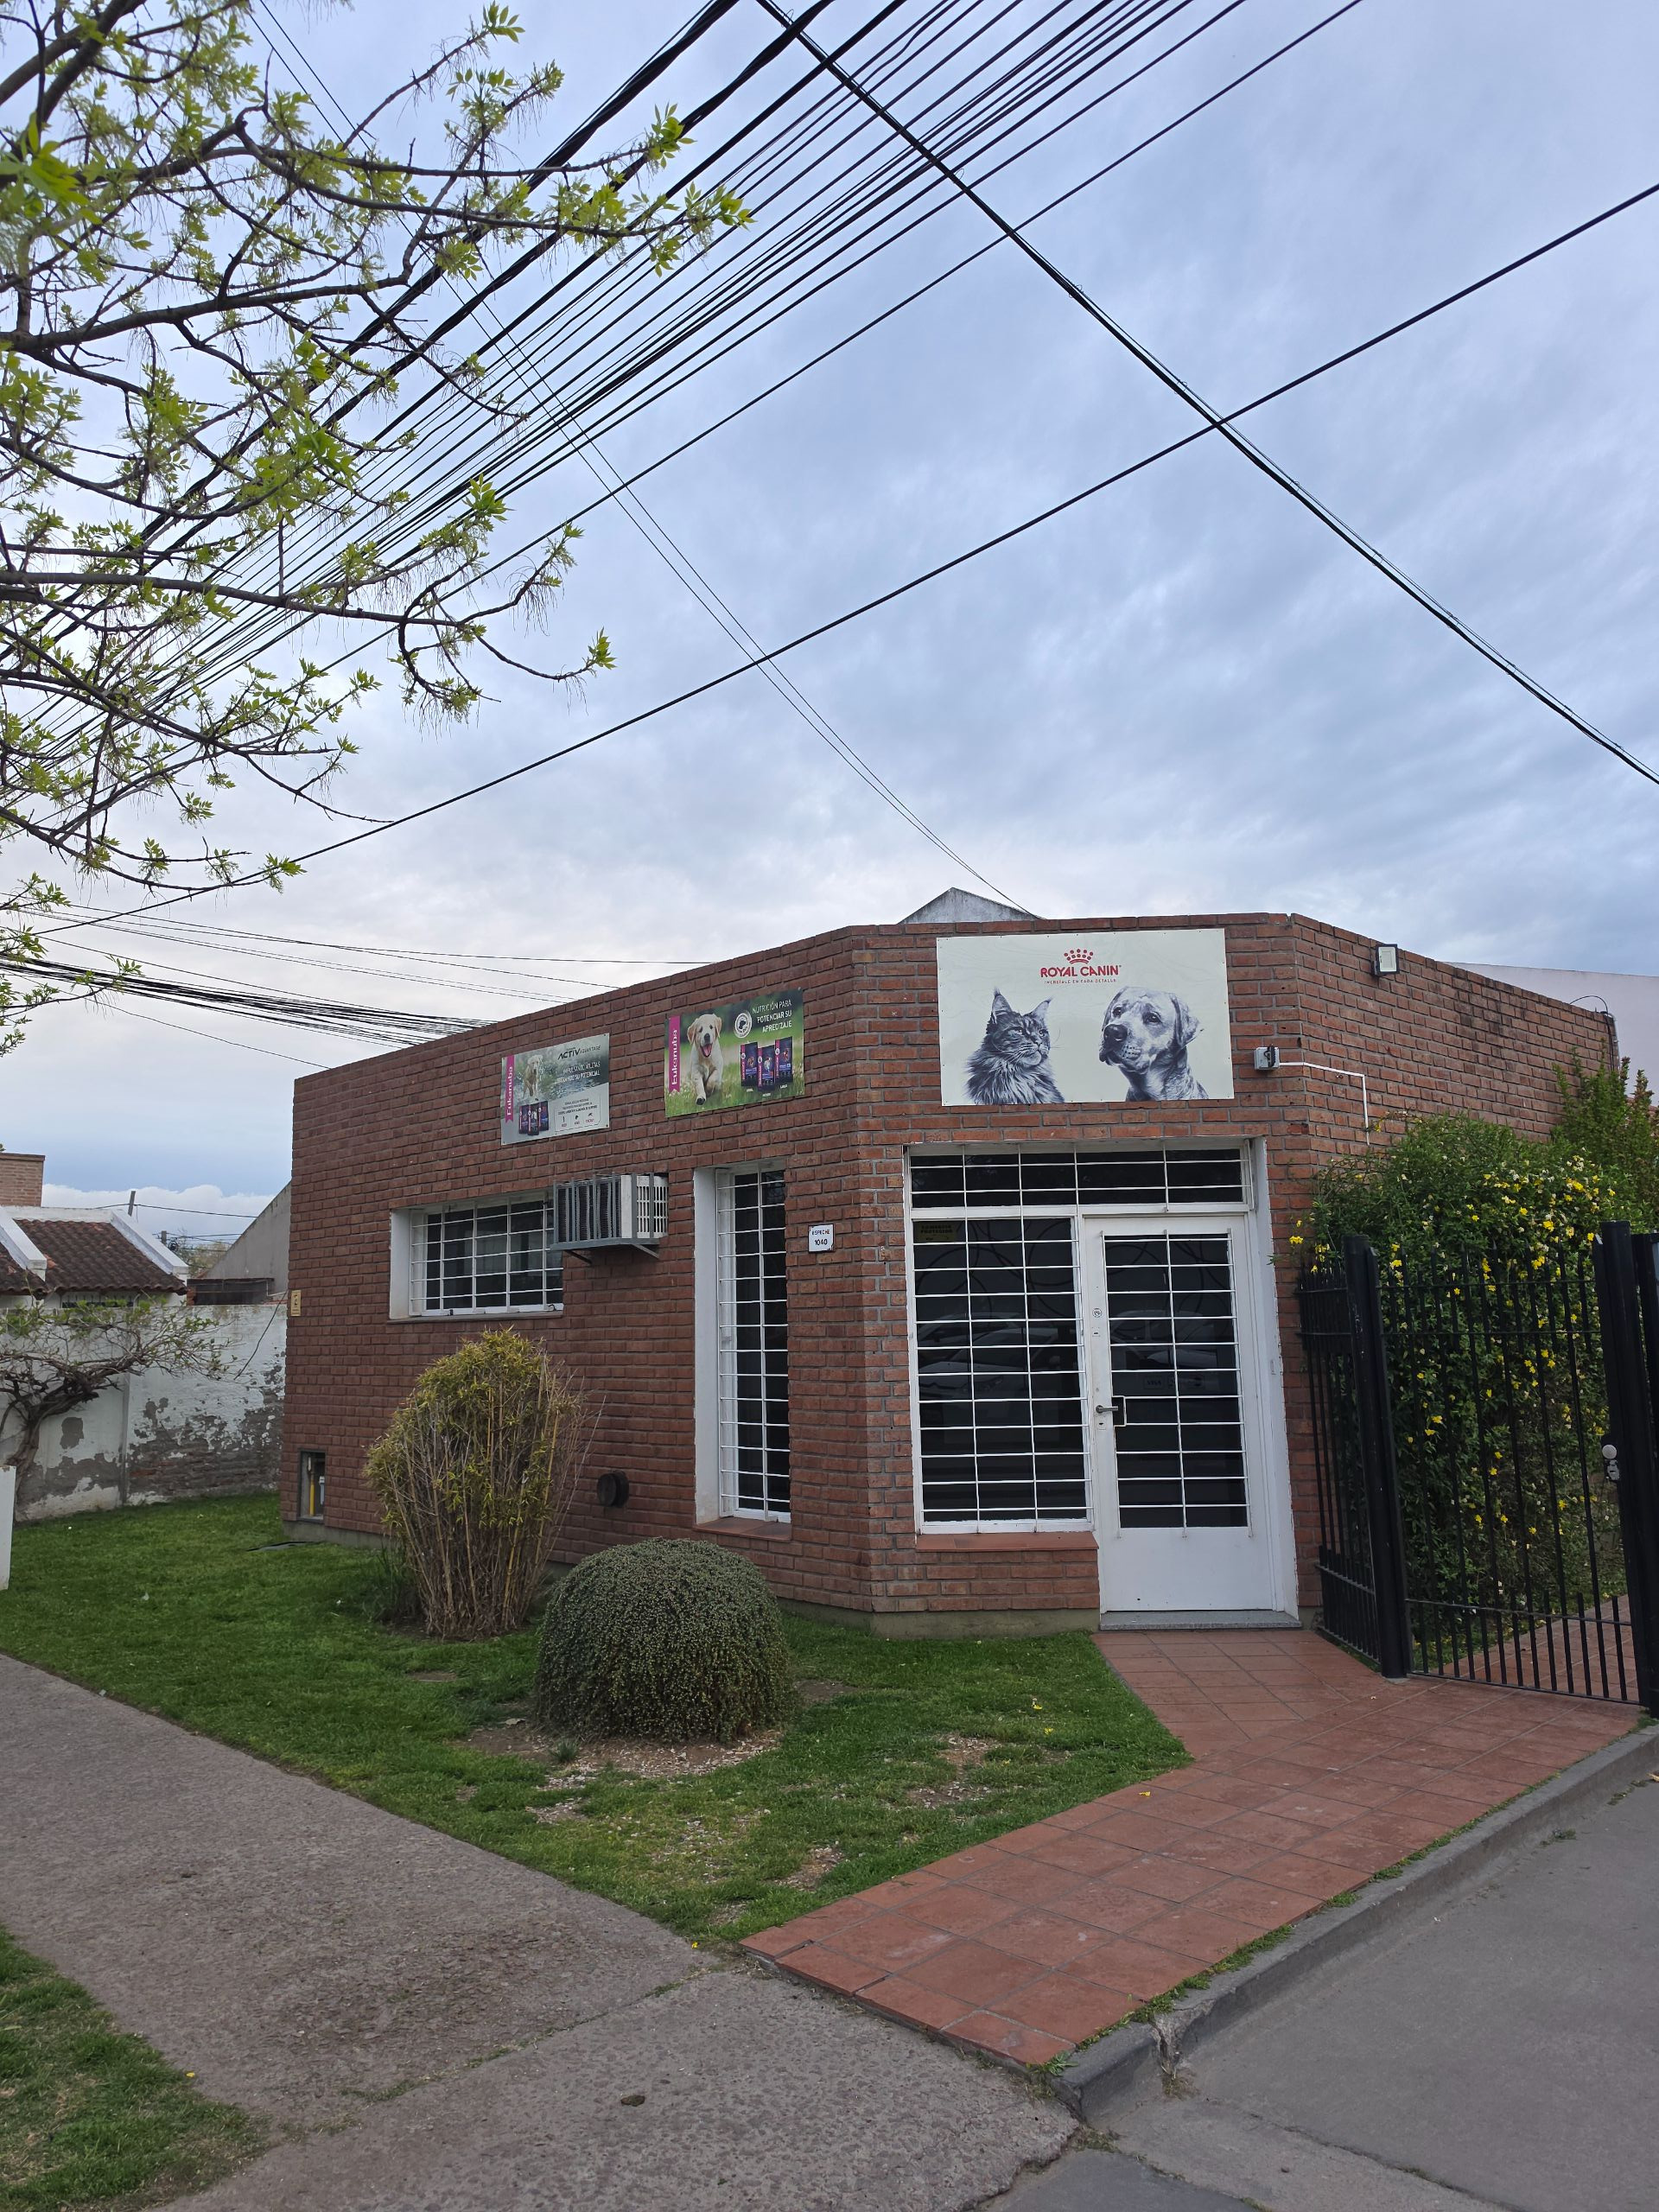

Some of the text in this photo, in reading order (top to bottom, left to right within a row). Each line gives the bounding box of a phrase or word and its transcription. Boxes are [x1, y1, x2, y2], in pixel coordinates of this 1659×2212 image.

[1040, 965, 1119, 978] ROYAL CANIN
[779, 998, 792, 1009] PARA
[756, 1009, 792, 1024] POTENCIAR SU
